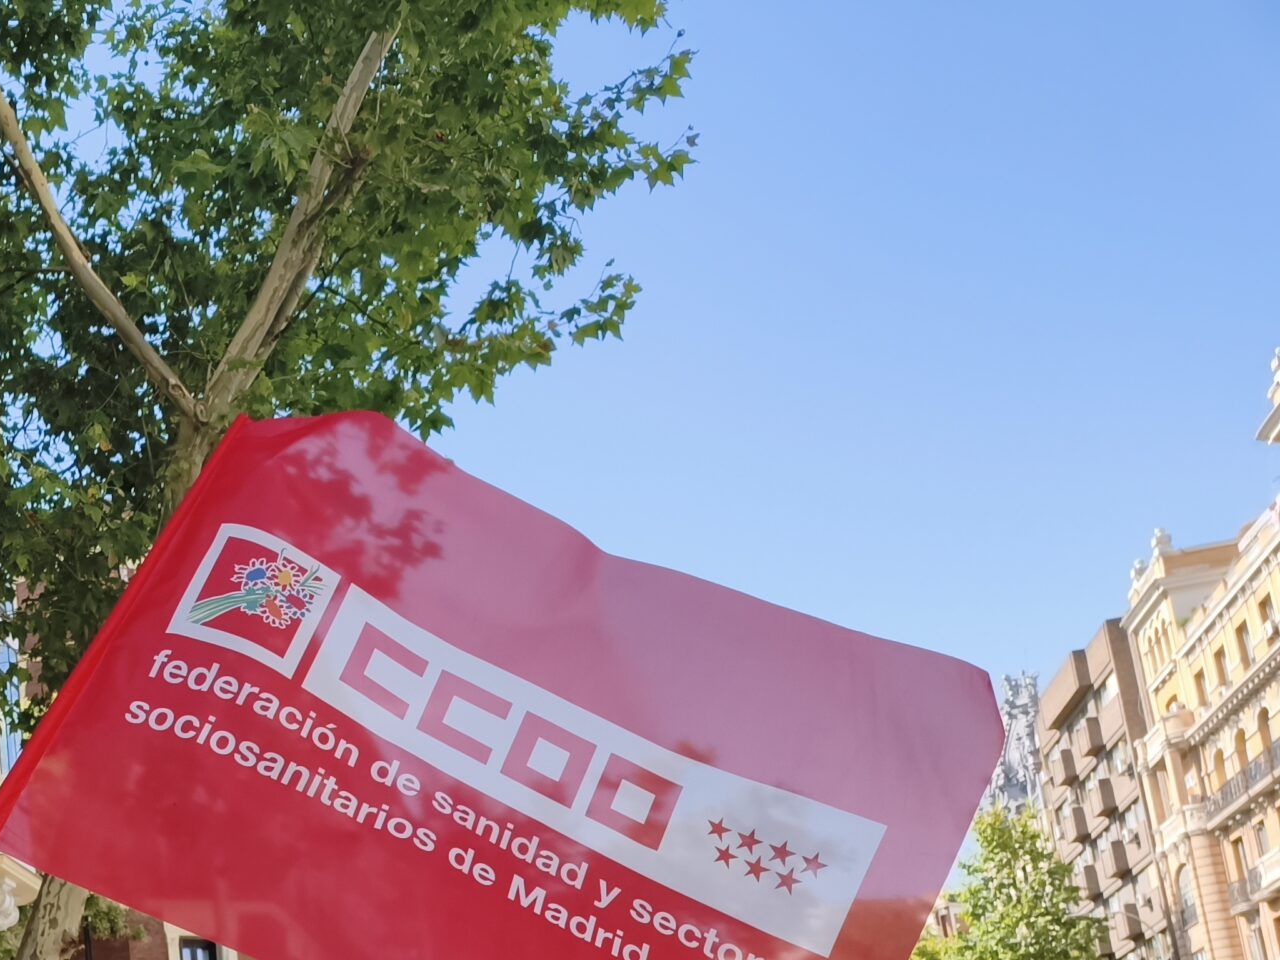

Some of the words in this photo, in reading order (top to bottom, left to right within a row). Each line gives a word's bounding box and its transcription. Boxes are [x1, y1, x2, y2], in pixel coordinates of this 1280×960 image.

[124, 700, 438, 852] sociosanitarios
[448, 846, 496, 887] de
[149, 650, 360, 766] federación
[370, 758, 422, 797] de
[430, 789, 589, 890] sanidad
[592, 878, 622, 910] y
[339, 621, 683, 851] CCOO
